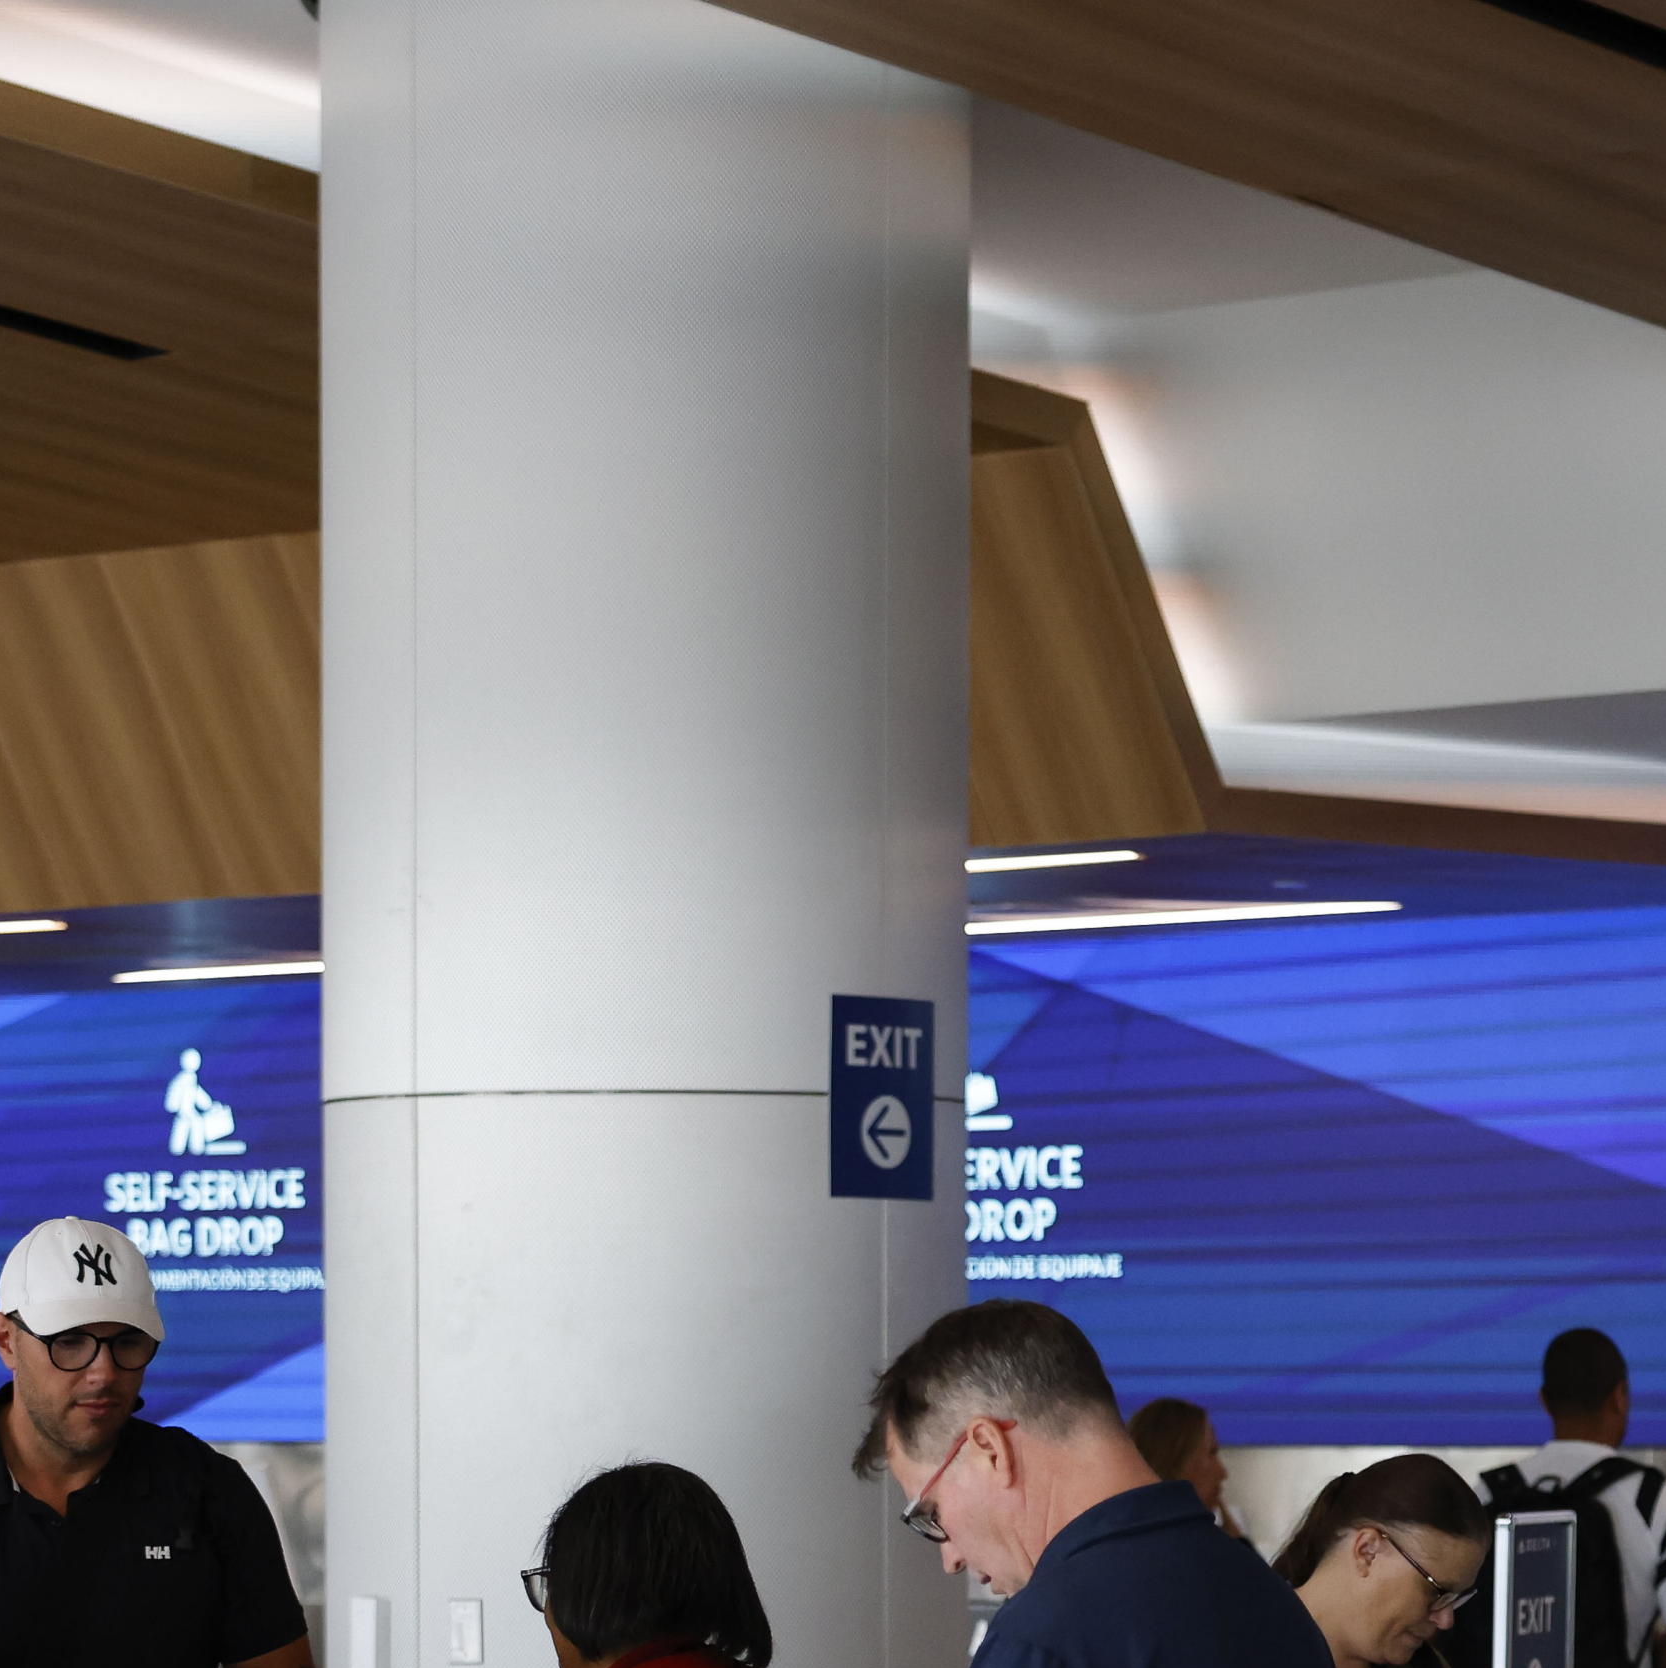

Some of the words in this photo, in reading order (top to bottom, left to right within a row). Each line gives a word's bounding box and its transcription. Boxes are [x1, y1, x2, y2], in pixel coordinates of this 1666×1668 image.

[845, 1023, 923, 1070] EXIT
[104, 1166, 306, 1213] SELF-SERVICE
[126, 1216, 192, 1258] BAG
[195, 1214, 284, 1258] DROP
[74, 1243, 118, 1286] NY
[145, 1545, 171, 1560] HH
[1517, 1596, 1555, 1635] EXIT
